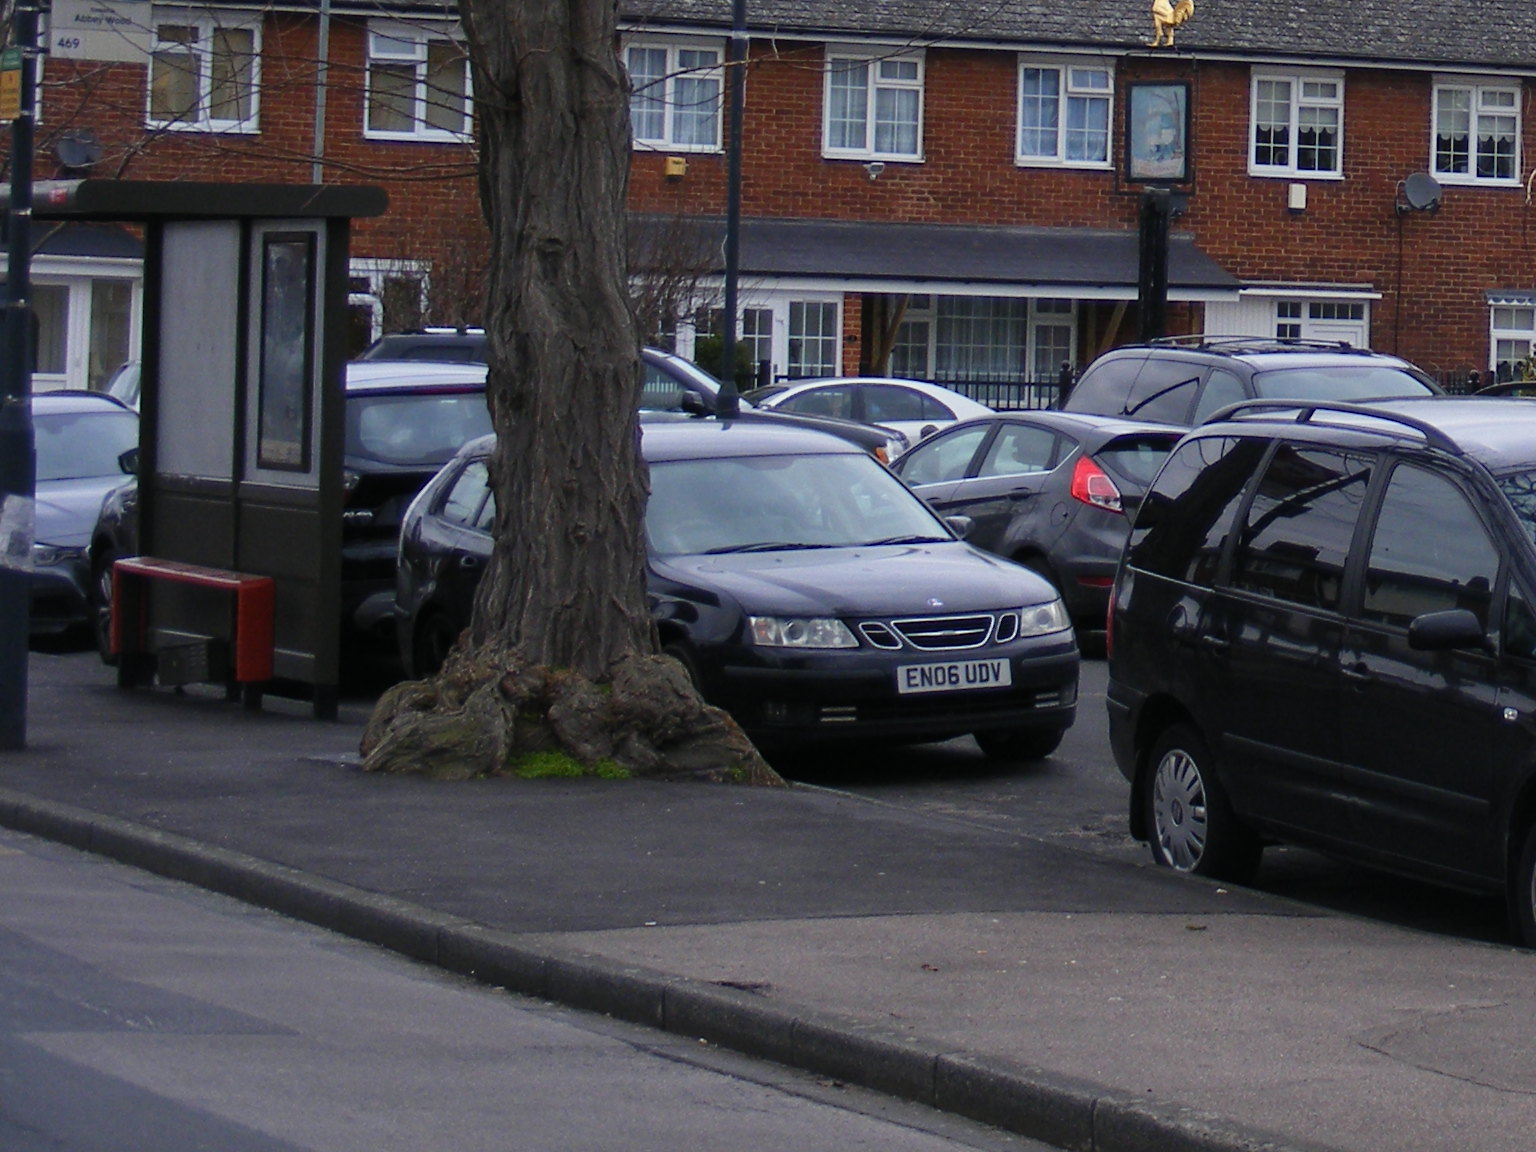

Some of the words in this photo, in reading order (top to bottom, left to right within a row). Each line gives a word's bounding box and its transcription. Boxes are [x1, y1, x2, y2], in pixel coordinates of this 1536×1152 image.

[57, 38, 80, 48] 469
[906, 665, 960, 687] EN06
[965, 662, 1001, 683] UDV
